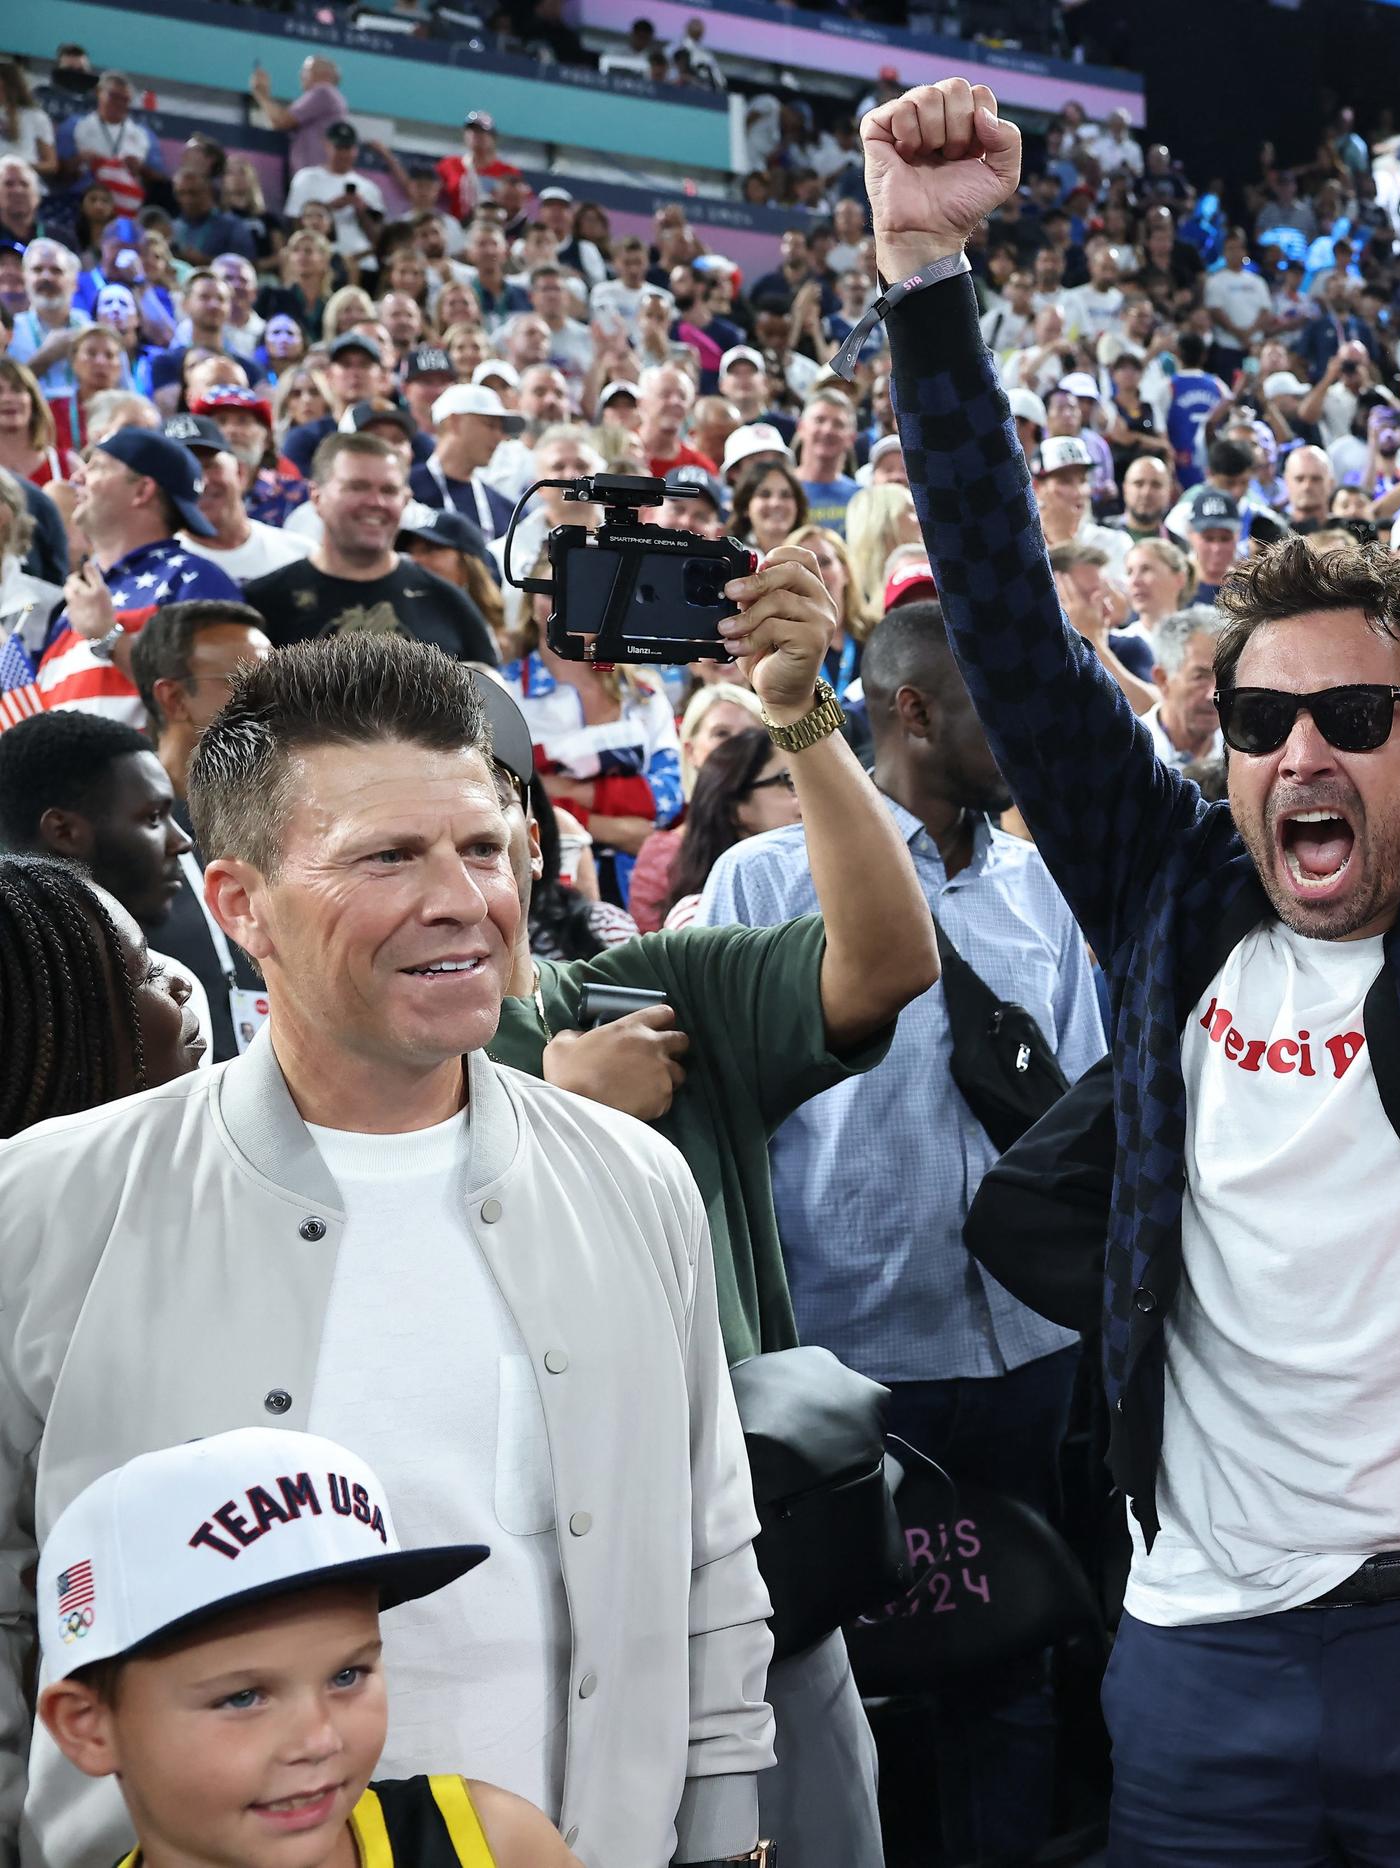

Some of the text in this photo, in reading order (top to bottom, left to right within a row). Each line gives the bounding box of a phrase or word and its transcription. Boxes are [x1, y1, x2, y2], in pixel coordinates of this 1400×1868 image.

[903, 275, 923, 291] STA
[609, 535, 652, 545] SMARTPHONE
[653, 539, 676, 547] CINEMA
[1200, 997, 1366, 1080] merci p
[187, 1472, 388, 1561] TEAM USA
